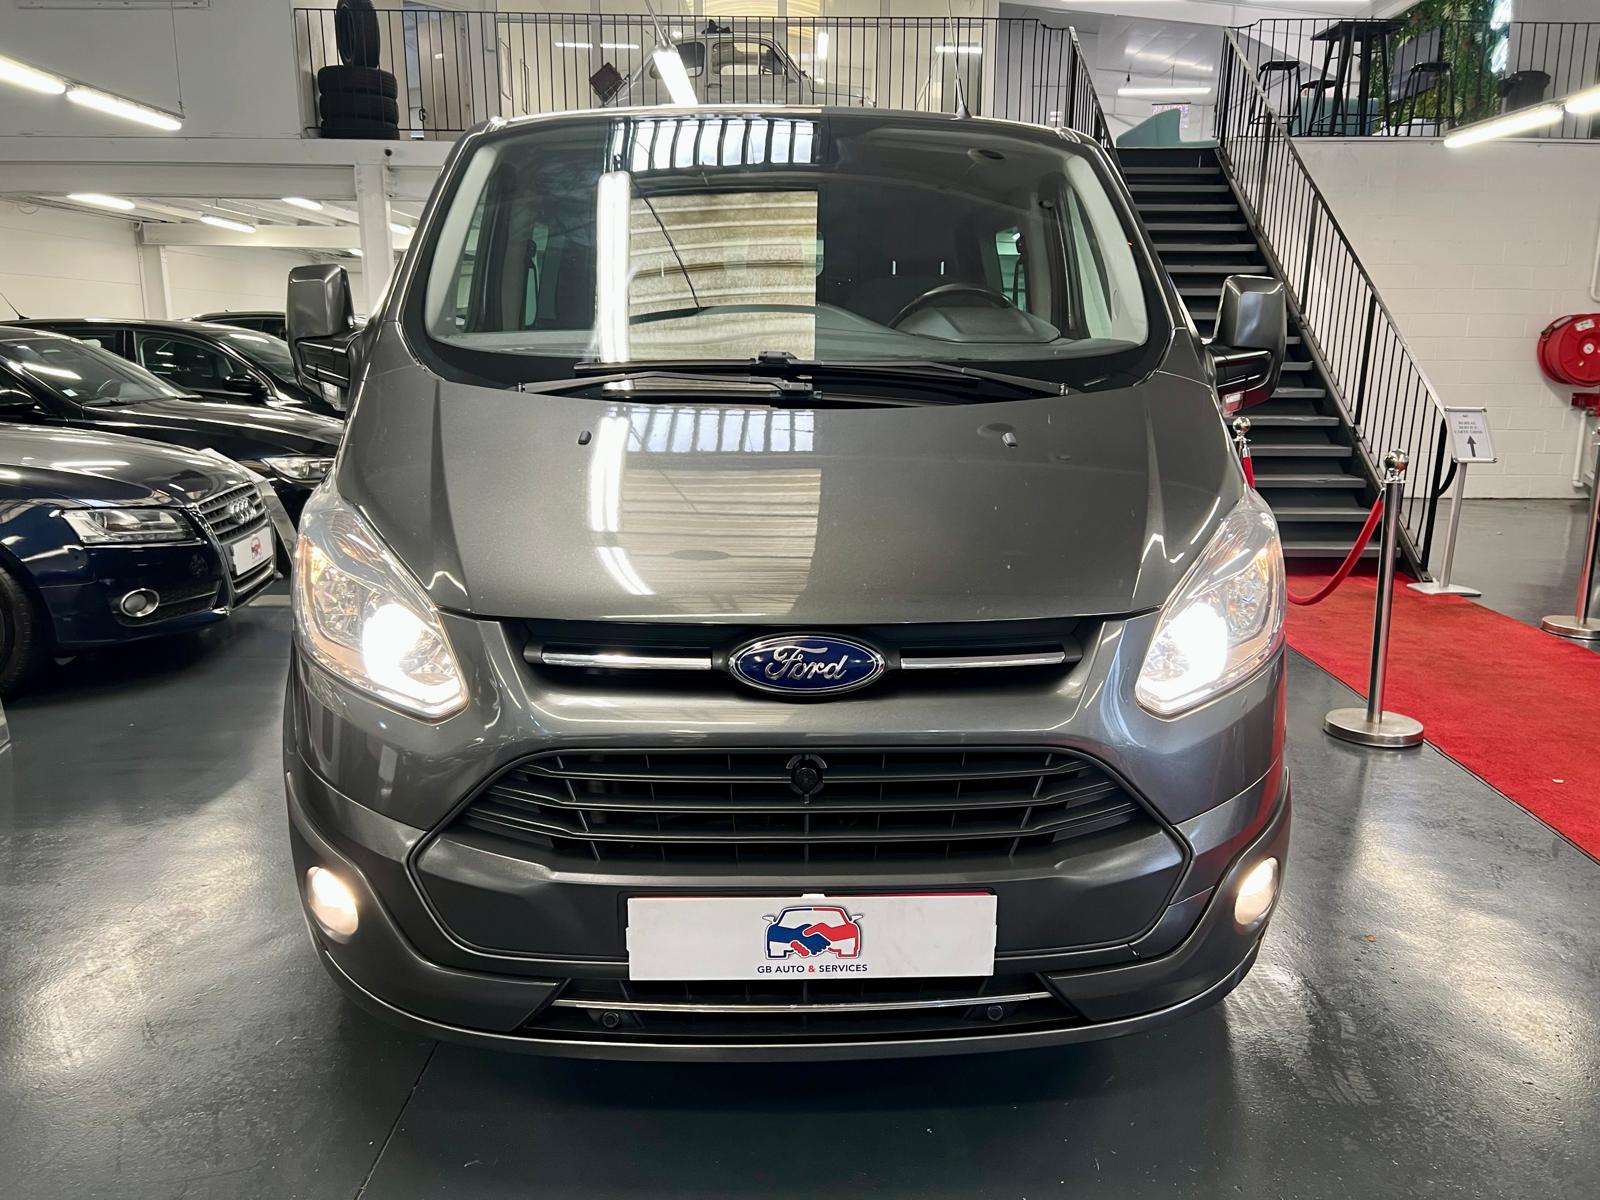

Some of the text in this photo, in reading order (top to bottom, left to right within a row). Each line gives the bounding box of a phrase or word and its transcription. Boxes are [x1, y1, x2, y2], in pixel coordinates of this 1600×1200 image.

[764, 645, 849, 680] Ford
[757, 964, 868, 974] GB AUTO & SERVICES
